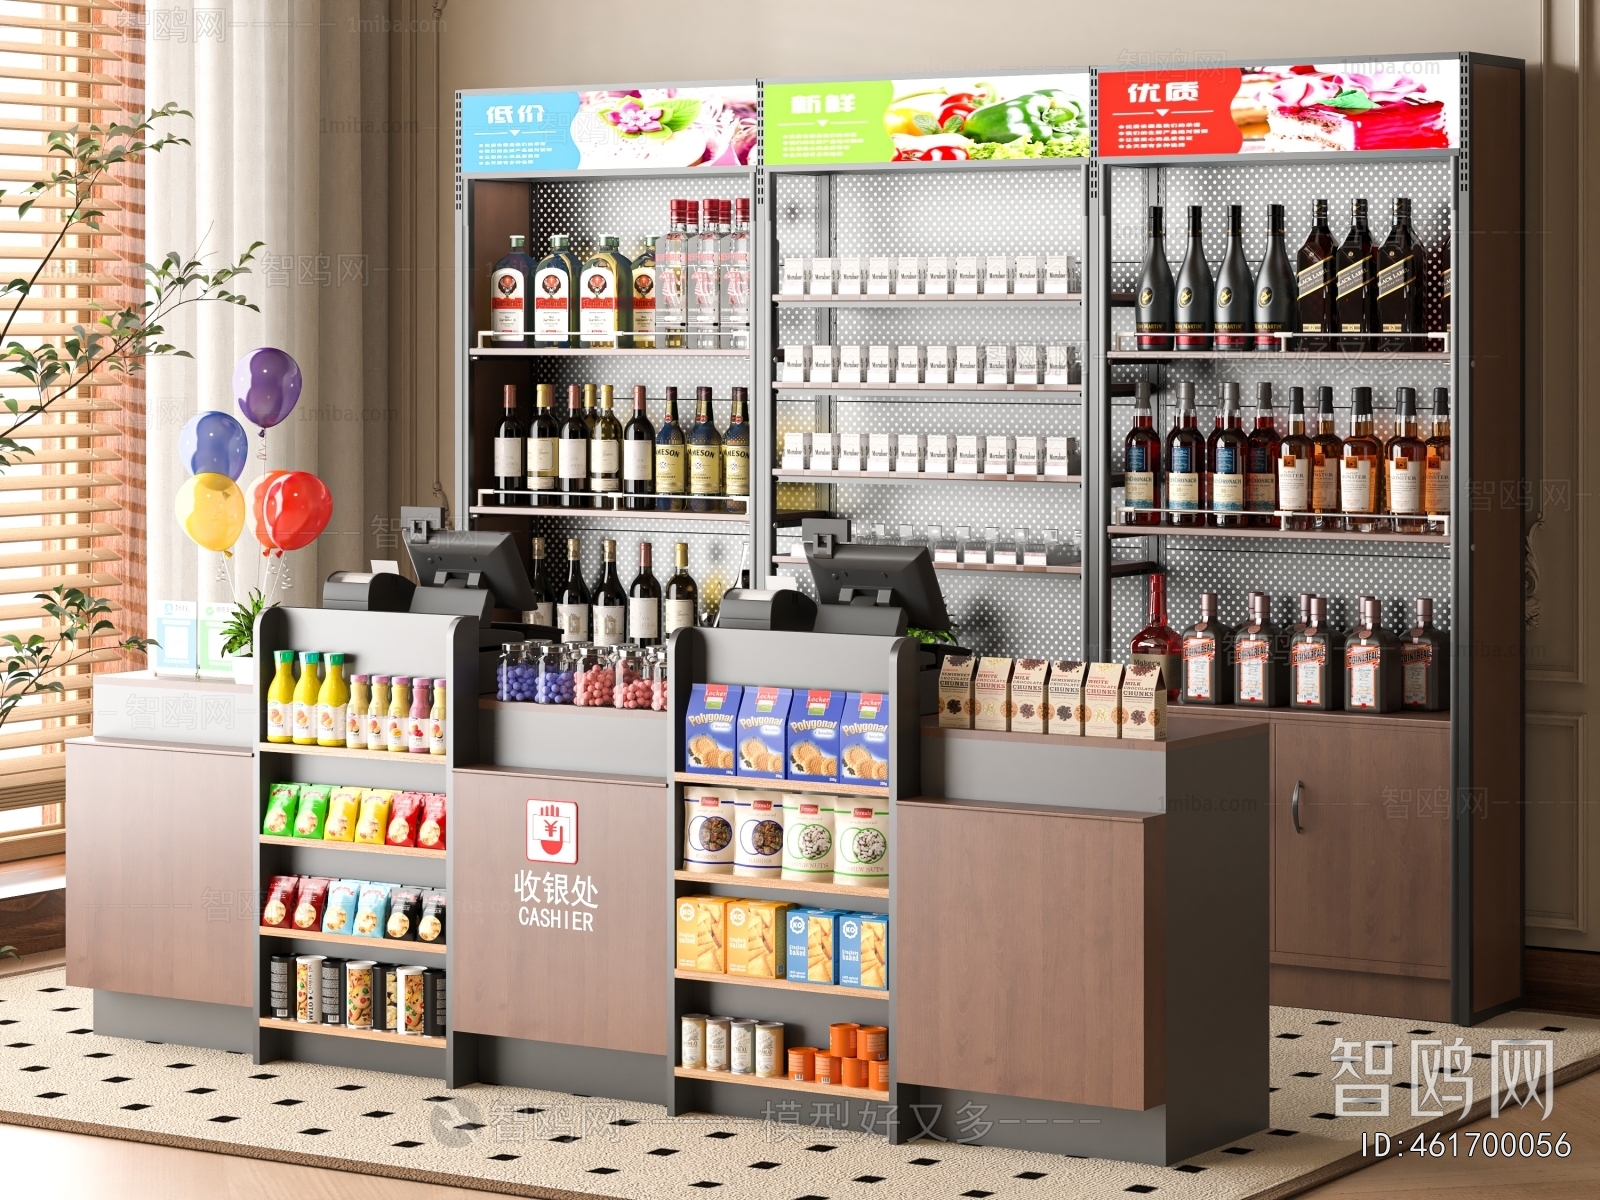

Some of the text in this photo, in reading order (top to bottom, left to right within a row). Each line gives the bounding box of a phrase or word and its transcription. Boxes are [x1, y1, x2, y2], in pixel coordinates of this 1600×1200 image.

[1127, 81, 1200, 103] 优质
[790, 93, 857, 114] 新鲜
[486, 104, 545, 125] 低价
[1184, 642, 1215, 657] COINTREAU
[1238, 645, 1269, 660] COINTREAU
[1294, 648, 1325, 663] COINTREAU
[1401, 648, 1433, 662] COINTREAU
[1348, 651, 1381, 666] COINTREAU
[705, 690, 727, 698] Locker
[756, 692, 778, 700] Locker
[808, 696, 830, 704] Locker
[860, 698, 882, 707] Locker
[688, 712, 735, 727] Polygonal
[739, 716, 784, 730] Polygonal
[790, 719, 838, 734] Polygonal
[842, 722, 889, 737] Polygonal
[514, 869, 599, 909] 收银处
[518, 906, 594, 932] CASHIER
